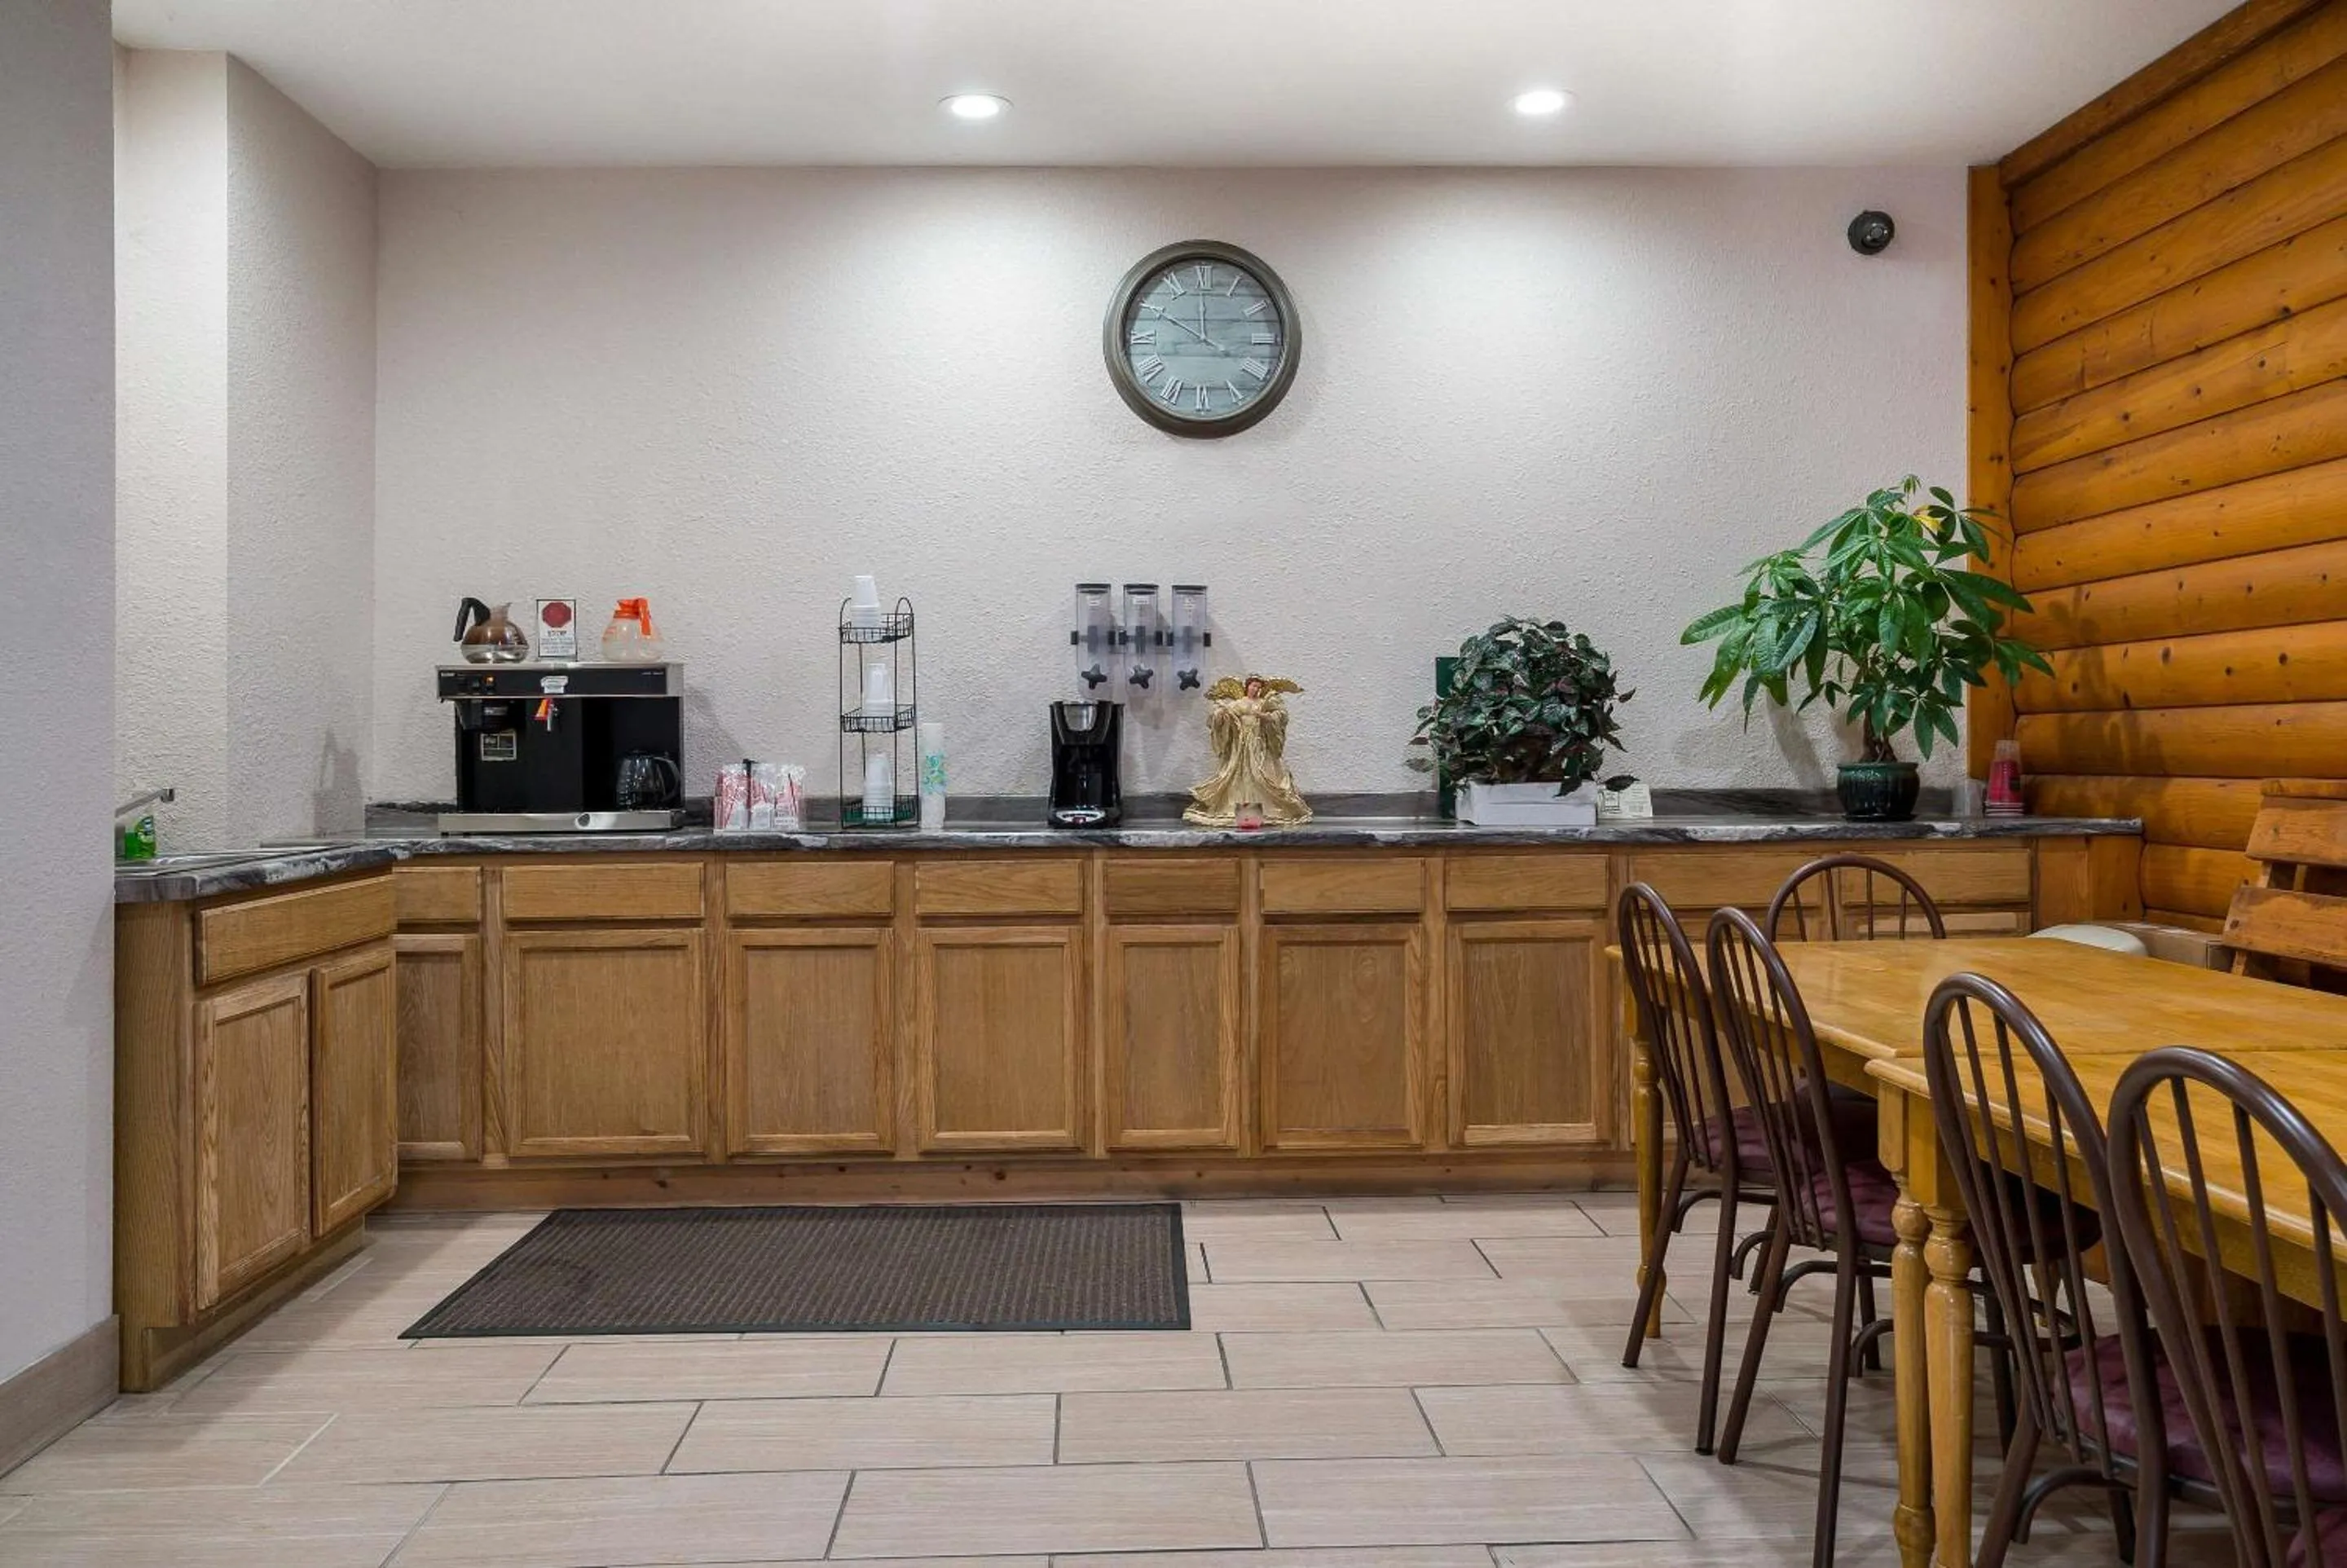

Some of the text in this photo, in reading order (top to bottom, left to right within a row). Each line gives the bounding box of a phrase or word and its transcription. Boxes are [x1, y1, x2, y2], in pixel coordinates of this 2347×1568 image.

[1163, 272, 1186, 300] XI
[1194, 266, 1213, 290] XII
[1242, 300, 1266, 318] II
[1130, 330, 1156, 344] IX
[1252, 333, 1275, 343] III
[1138, 354, 1165, 382] VIII
[1160, 377, 1183, 405] VII
[1196, 385, 1212, 411] VI
[1226, 380, 1244, 404] V
